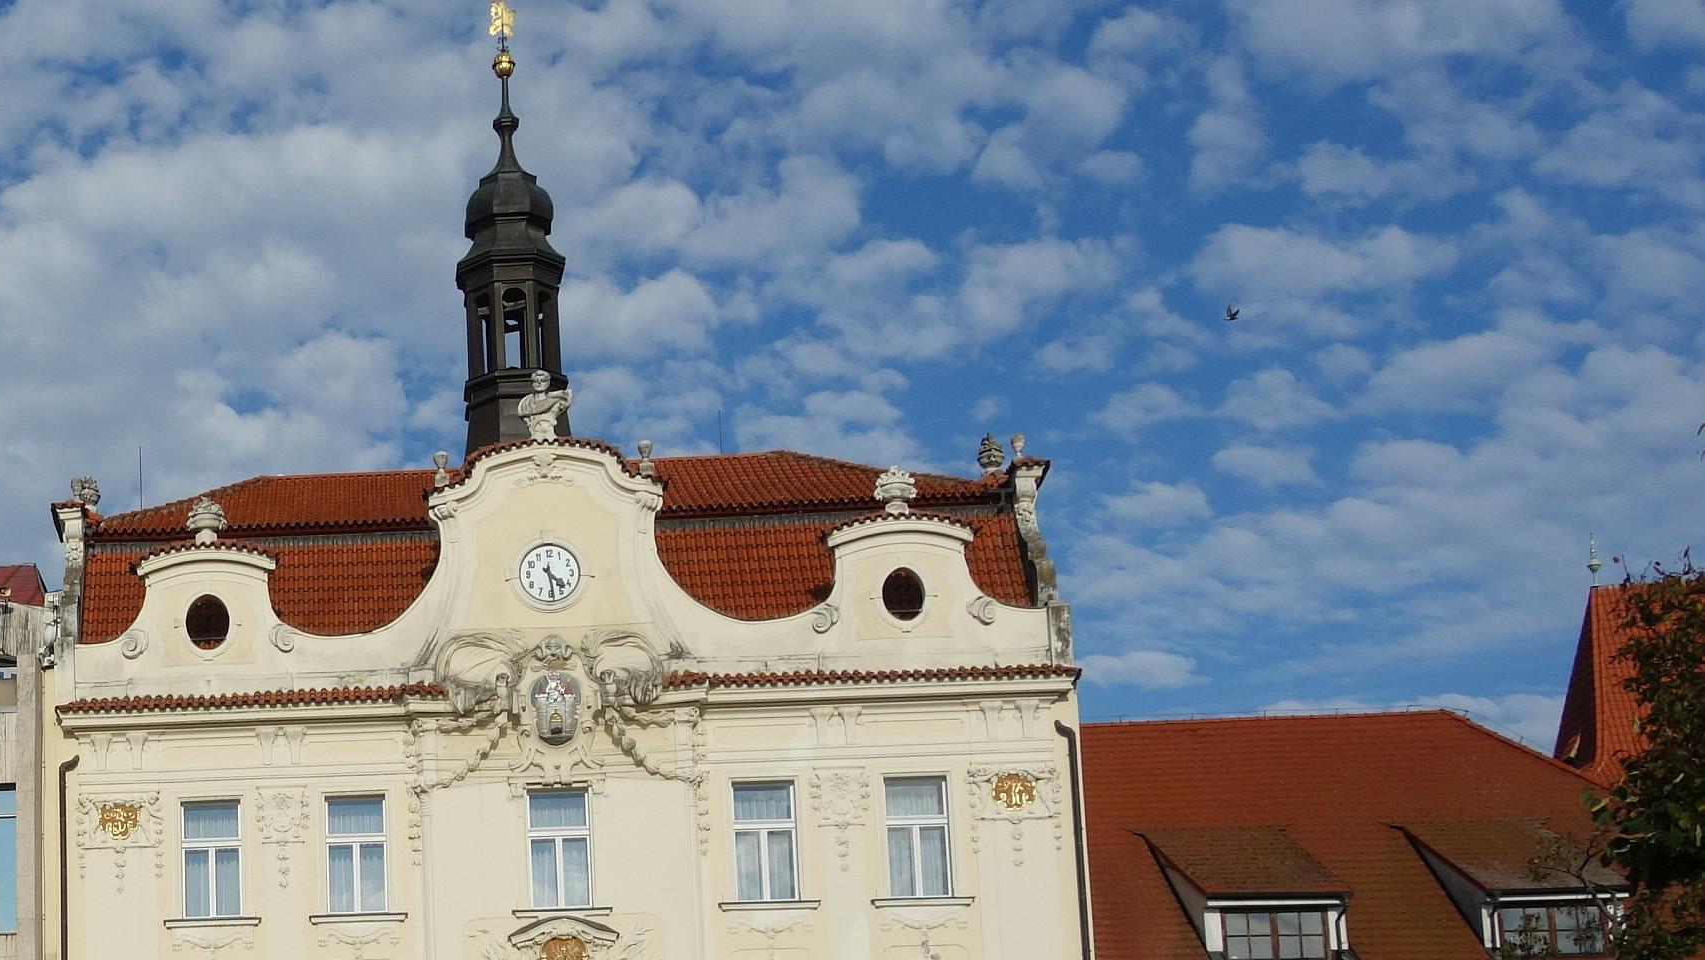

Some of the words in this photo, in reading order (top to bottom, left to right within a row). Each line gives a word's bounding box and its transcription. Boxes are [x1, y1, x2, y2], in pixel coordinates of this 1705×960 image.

[536, 553, 541, 561] 11
[558, 552, 561, 560] 1
[528, 560, 535, 568] 10
[566, 559, 571, 567] 2
[529, 581, 534, 589] 8
[567, 579, 571, 588] 4
[538, 588, 543, 596] 7
